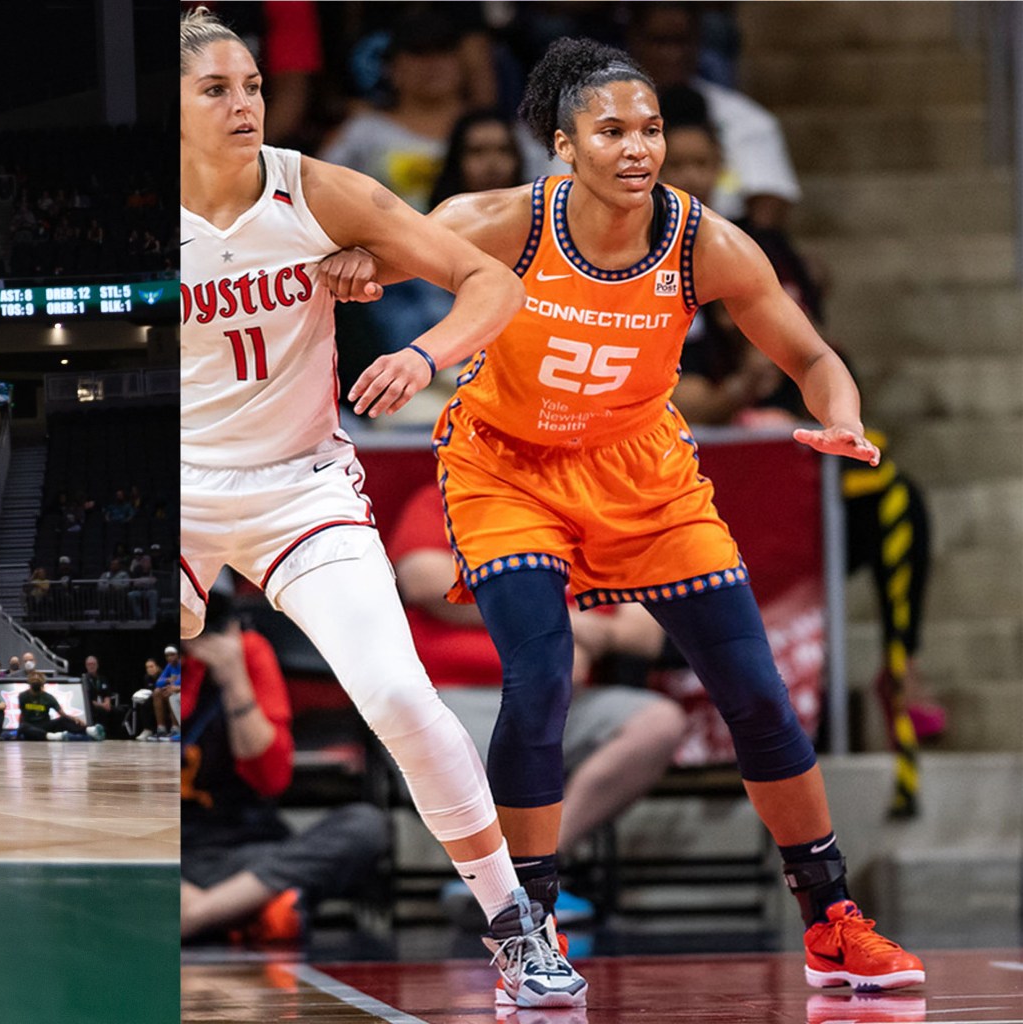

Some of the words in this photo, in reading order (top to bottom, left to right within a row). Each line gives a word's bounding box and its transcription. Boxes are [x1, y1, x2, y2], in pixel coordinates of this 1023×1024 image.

[45, 287, 78, 301] DREB:
[78, 286, 91, 299] 12
[99, 286, 124, 299] STL:
[123, 285, 132, 298] 5
[656, 282, 677, 292] Post
[0, 289, 24, 303] AST:
[0, 303, 27, 316] TOS:
[26, 303, 34, 316] 9
[46, 301, 78, 315] OREB:
[78, 301, 85, 314] 1
[100, 300, 125, 313] BLK:
[125, 299, 132, 312] 1
[525, 295, 672, 330] CONNECTICUT
[223, 326, 269, 381] 11
[538, 336, 640, 396] 25
[541, 397, 569, 411] Yale
[537, 420, 586, 432] Health
